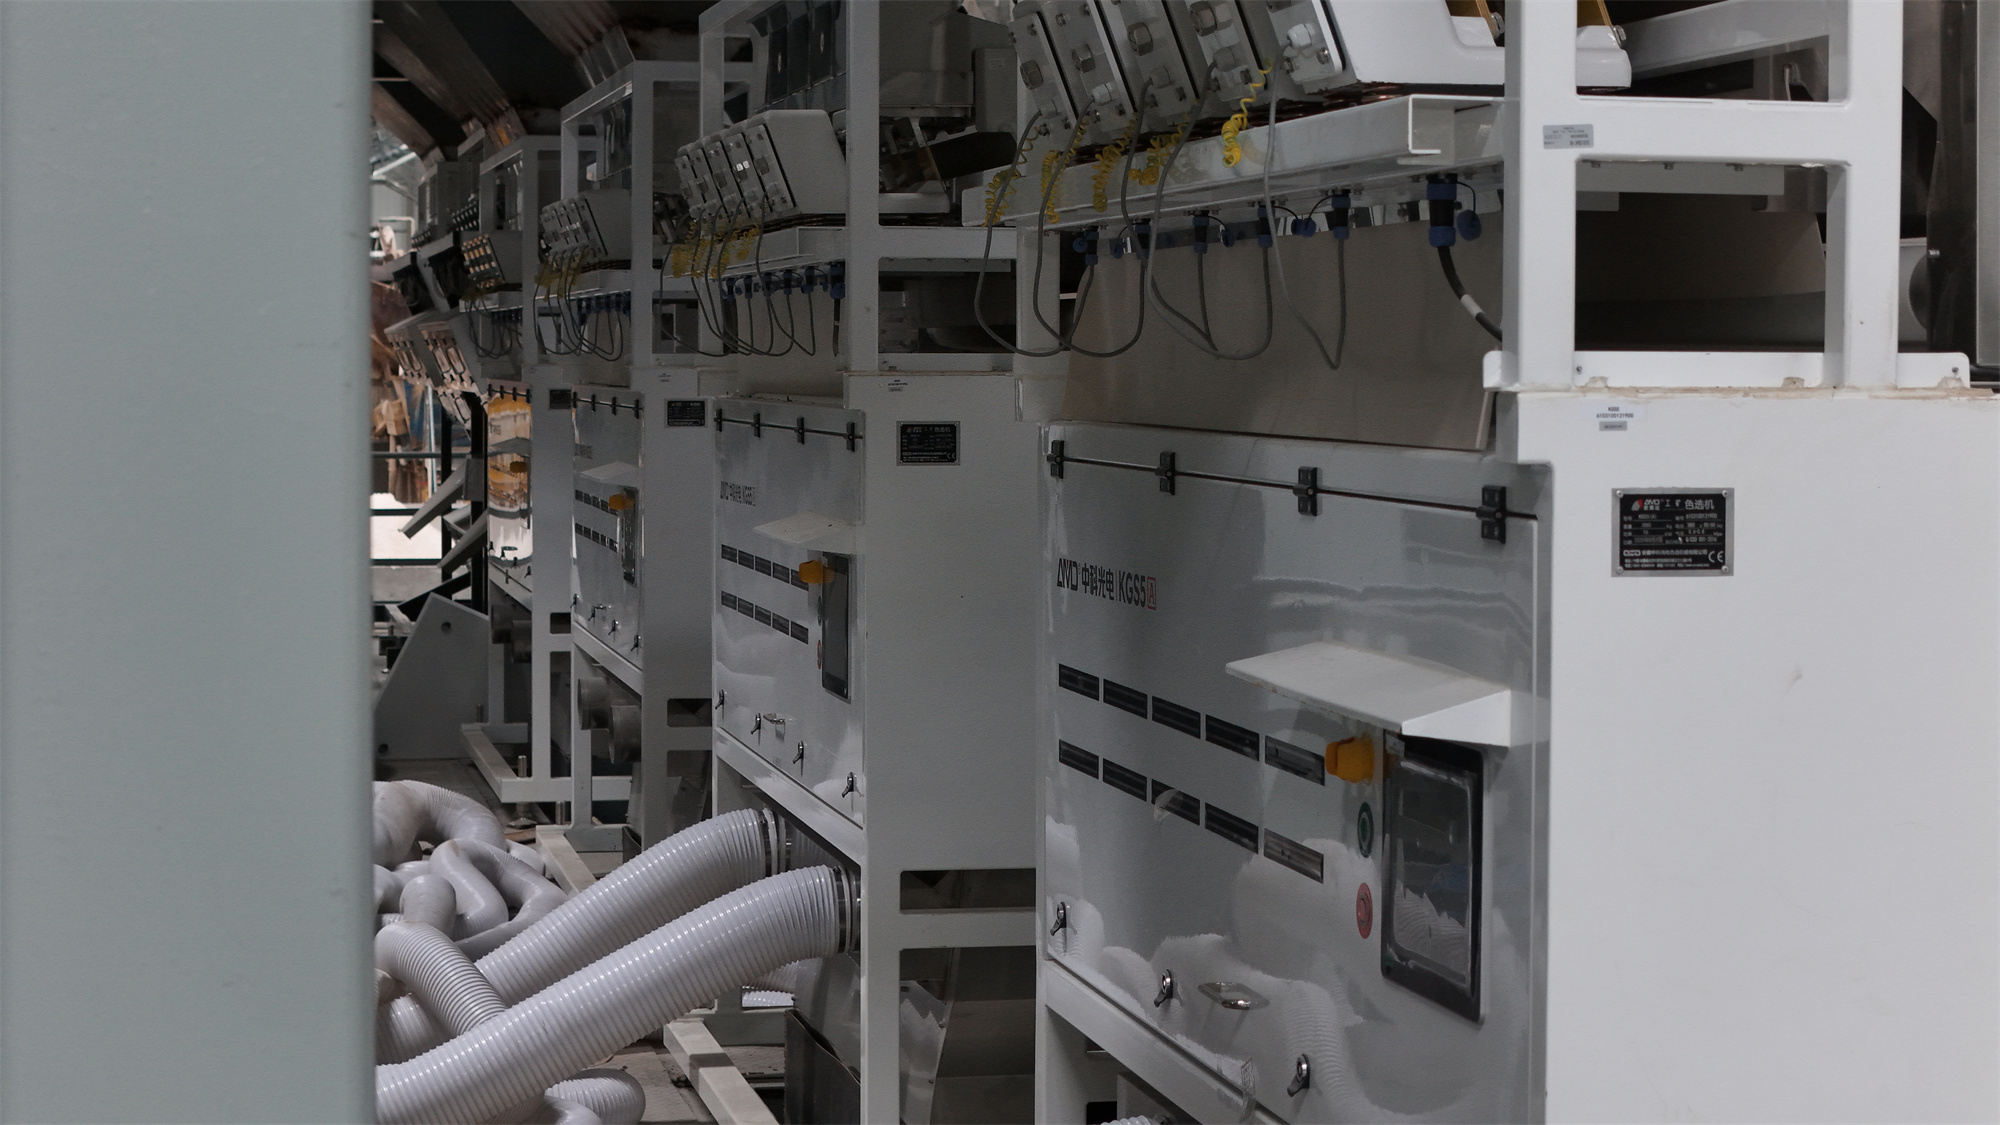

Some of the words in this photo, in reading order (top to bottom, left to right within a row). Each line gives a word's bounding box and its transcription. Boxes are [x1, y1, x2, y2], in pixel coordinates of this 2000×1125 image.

[1684, 499, 1715, 510] 色选机
[1081, 562, 1115, 601] 中科光电
[1119, 570, 1146, 608] KGS5
